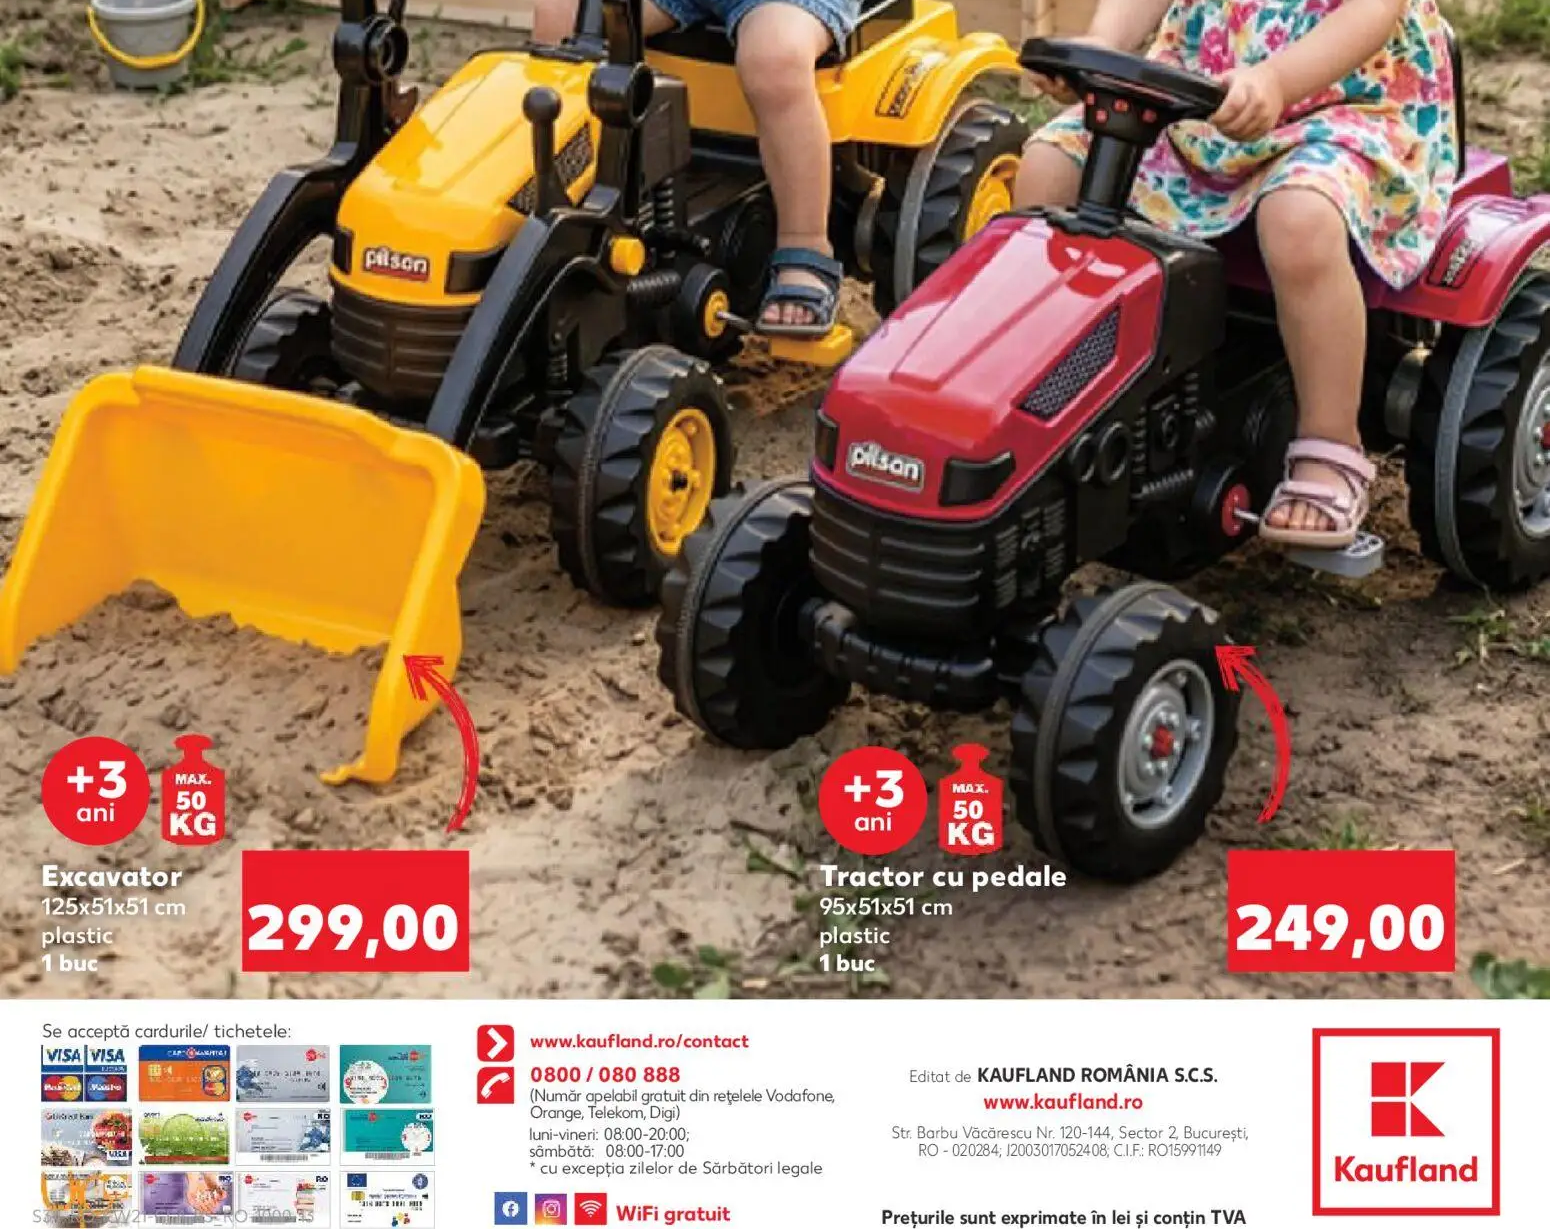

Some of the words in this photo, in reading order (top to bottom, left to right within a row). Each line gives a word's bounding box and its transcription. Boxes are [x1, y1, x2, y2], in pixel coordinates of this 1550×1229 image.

[67, 761, 127, 799] +3
[175, 774, 212, 785] MAX.
[844, 770, 904, 808] +3
[952, 784, 989, 794] MAX.
[176, 791, 206, 810] 50
[954, 800, 983, 820] 50
[77, 803, 114, 822] ani
[854, 812, 891, 831] ani
[170, 812, 216, 836] KG
[948, 822, 994, 845] KG
[42, 864, 183, 887] Excavator
[819, 864, 924, 887] Tractor
[932, 871, 964, 887] cu
[972, 864, 1067, 893] pedale
[41, 897, 148, 916] 125x51x51
[154, 902, 186, 916] cm
[819, 897, 914, 916] 95x51x51
[921, 903, 953, 915] cm
[42, 926, 113, 948] plastic
[248, 904, 458, 958] 299,00
[820, 926, 890, 948] plastic
[1236, 904, 1444, 958] 249,00
[41, 953, 52, 972] 1
[59, 953, 98, 972] buc
[819, 953, 829, 972] 1
[837, 954, 875, 972] buc
[42, 1023, 62, 1039] Se
[67, 1024, 130, 1042] acceptă
[134, 1023, 209, 1039] cardurile/
[213, 1023, 291, 1039] tichetele:
[529, 1033, 750, 1049] www.kaufland.ro/contact
[46, 1048, 81, 1063] VISA
[90, 1048, 125, 1063] VISA
[530, 1066, 582, 1084] 0800
[585, 1066, 594, 1083] /
[598, 1066, 637, 1083] 080
[642, 1066, 681, 1083] 888
[909, 1069, 951, 1083] Editat
[954, 1070, 972, 1083] de
[977, 1067, 1076, 1083] KAUFLAND
[1081, 1063, 1170, 1083] ROMÂNIA
[1174, 1066, 1218, 1083] S.C.S.
[529, 1087, 582, 1104] (Număr
[585, 1088, 638, 1106] apelabil
[641, 1089, 687, 1106] gratuit
[688, 1088, 710, 1103] din
[765, 1088, 835, 1104] Vodafone,
[983, 1092, 1144, 1110] www.kaufland.ro
[530, 1105, 585, 1123] Orange,
[587, 1103, 648, 1121] Telekom,
[649, 1104, 681, 1123] Digi)
[529, 1127, 599, 1141] luni-vineri:
[603, 1126, 690, 1143] 08:00-20:00;
[891, 1125, 912, 1140] Str.
[917, 1125, 958, 1140] Barbu
[962, 1126, 1032, 1140] Văcărescu
[1036, 1125, 1055, 1139] Nr.
[1059, 1125, 1114, 1141] 120-144,
[1119, 1125, 1163, 1140] Sector
[1168, 1125, 1179, 1142] 2,
[529, 1144, 595, 1158] sâmbătă:
[605, 1143, 685, 1158] 08:00-17:00
[918, 1143, 939, 1157] RO
[952, 1143, 1002, 1158] 020284;
[1006, 1143, 1110, 1158] J2003017052408;
[1113, 1143, 1144, 1157] C.I.F.:
[1148, 1143, 1222, 1157] RO15991149
[540, 1164, 558, 1175] cu
[629, 1161, 674, 1175] zilelor
[678, 1160, 698, 1175] de
[702, 1160, 773, 1175] Sărbători
[777, 1160, 823, 1178] legale
[1334, 1155, 1479, 1183] Kaufland
[615, 1204, 659, 1222] WiFi
[663, 1205, 731, 1226] gratuit
[959, 1210, 997, 1225] sunt
[1001, 1210, 1087, 1229] exprimate
[1090, 1209, 1107, 1225] în
[1112, 1209, 1131, 1225] lei
[1210, 1209, 1247, 1225] TVA
